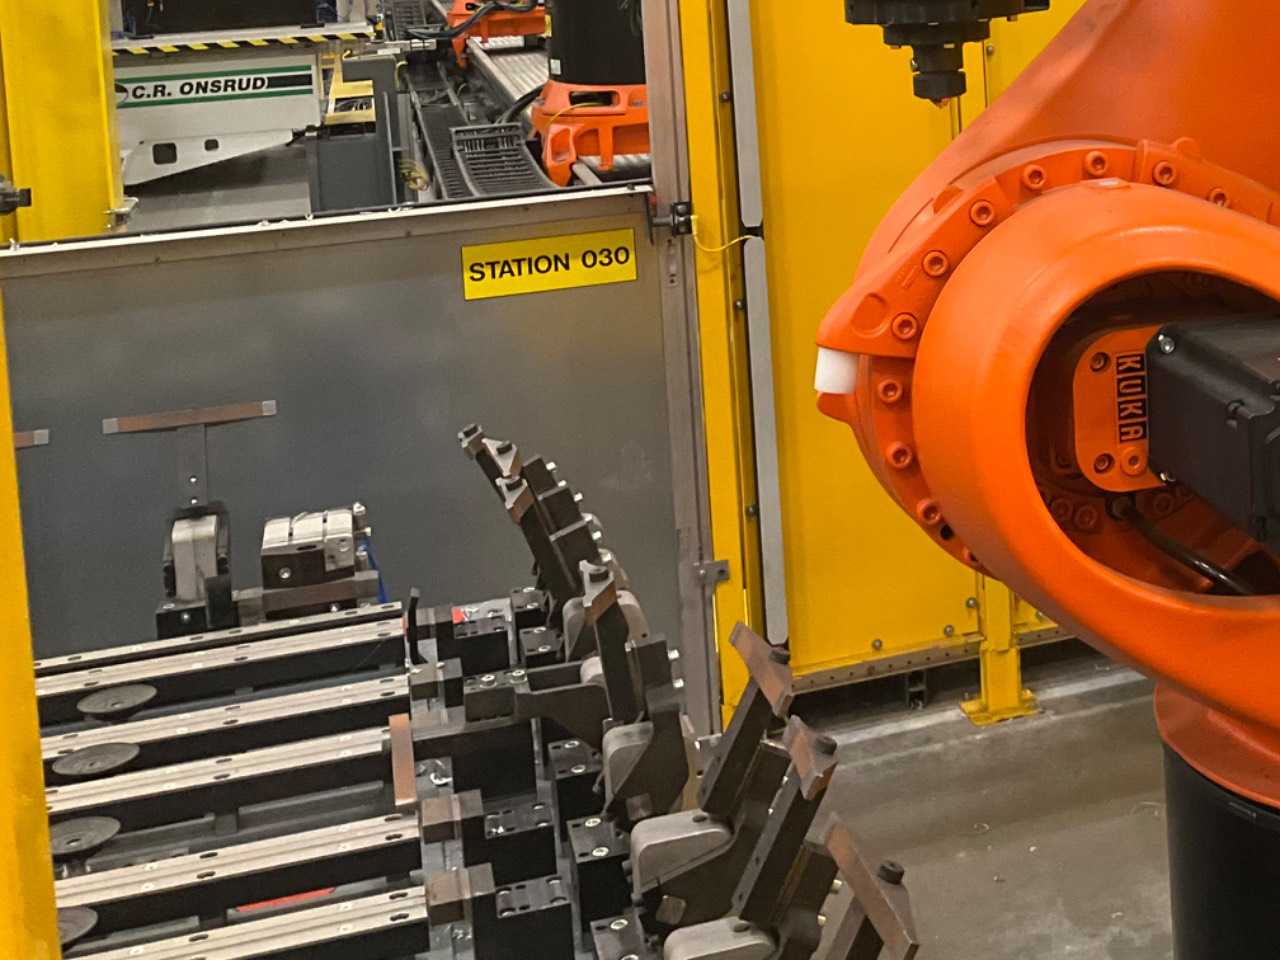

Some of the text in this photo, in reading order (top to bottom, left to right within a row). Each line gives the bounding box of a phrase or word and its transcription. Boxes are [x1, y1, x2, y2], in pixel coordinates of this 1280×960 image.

[131, 76, 267, 100] C.R. ONSRUD
[469, 246, 630, 282] STATION 030
[1117, 354, 1146, 442] KUKA
